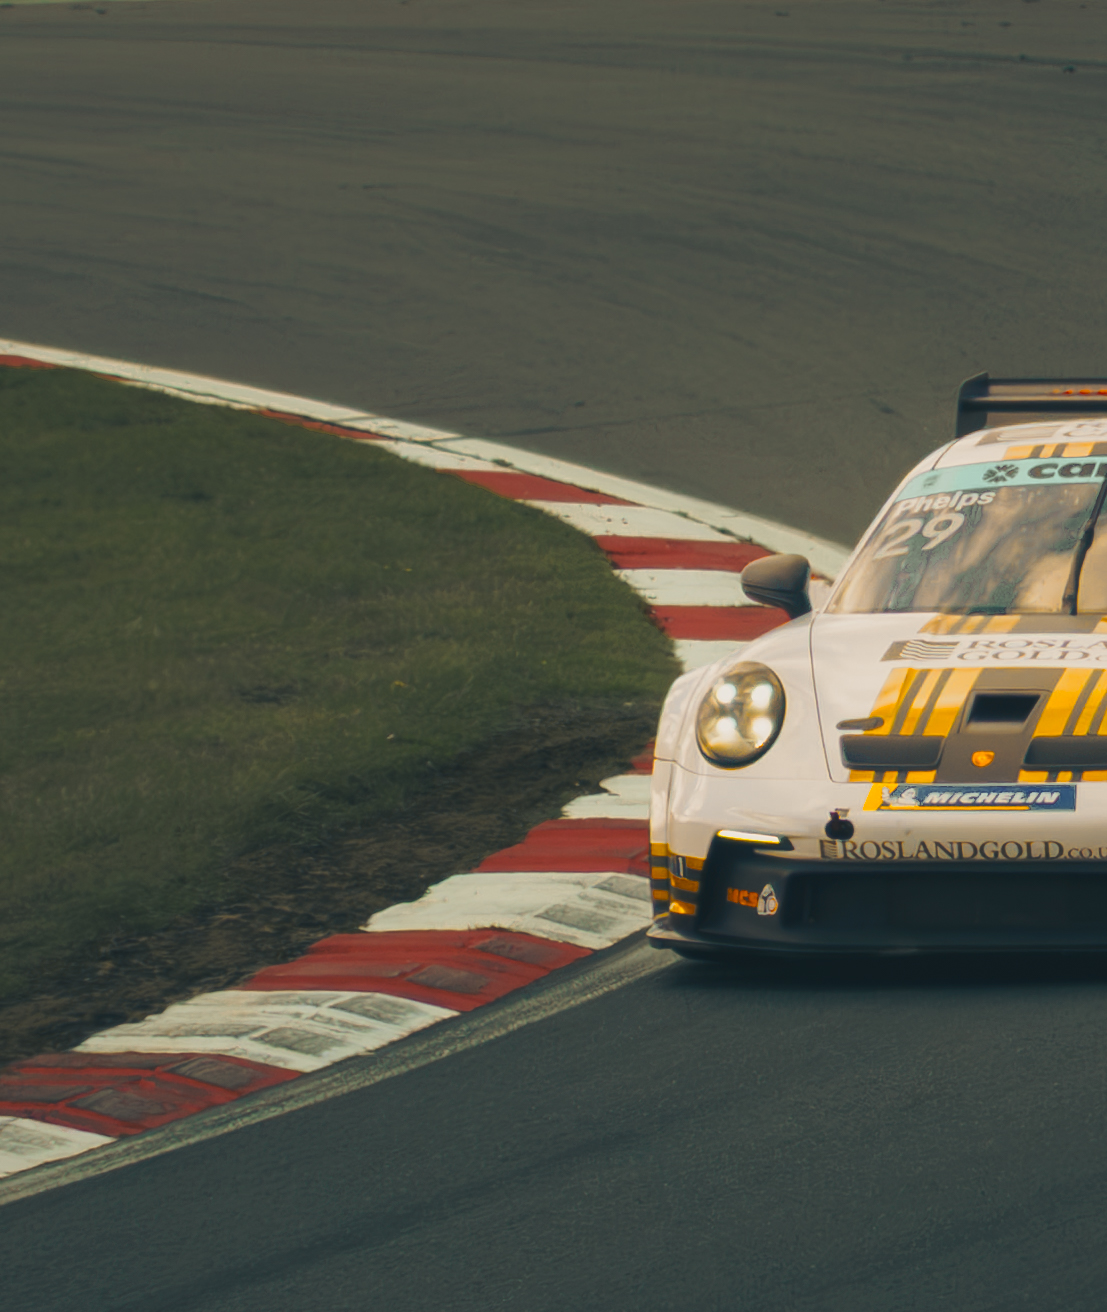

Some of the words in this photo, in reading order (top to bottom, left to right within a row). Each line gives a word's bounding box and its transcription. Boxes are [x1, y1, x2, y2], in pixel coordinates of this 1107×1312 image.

[899, 490, 997, 513] Phelps
[873, 512, 965, 560] 29
[923, 791, 1060, 805] MICHELIN
